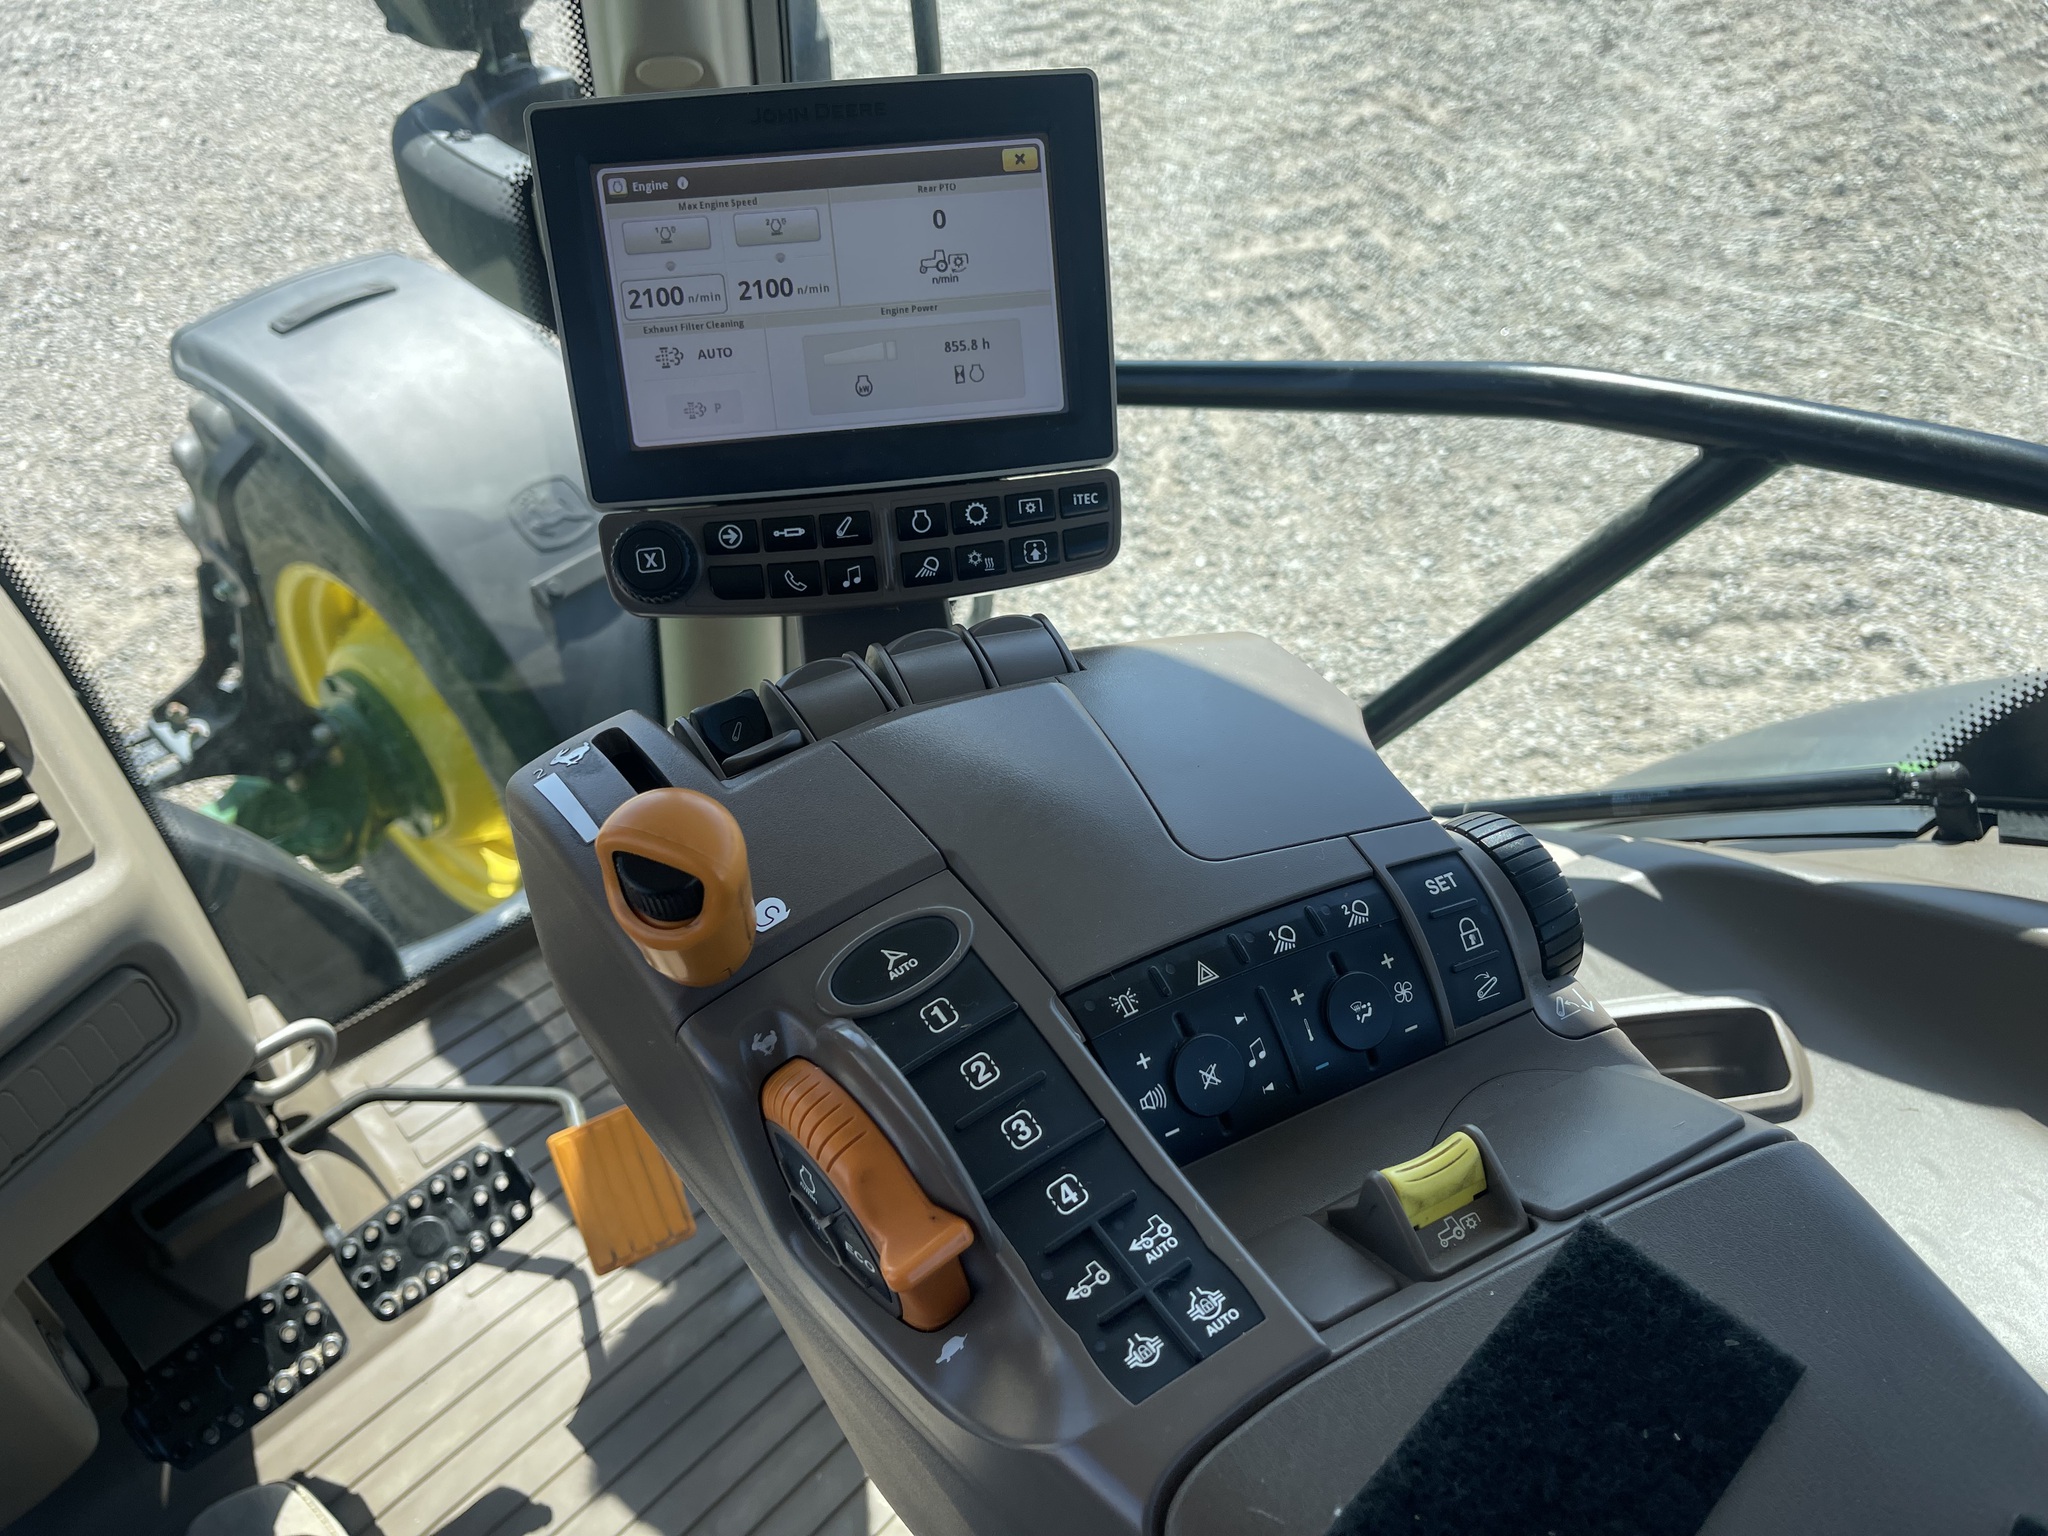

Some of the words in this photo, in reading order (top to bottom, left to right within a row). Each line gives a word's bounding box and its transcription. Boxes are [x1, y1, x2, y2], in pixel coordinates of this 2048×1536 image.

[632, 179, 669, 194] Engine
[917, 184, 937, 194] Rear
[939, 182, 957, 192] PTO
[678, 202, 698, 211] Max
[699, 199, 730, 212] Engine
[731, 196, 758, 210] Speed
[932, 208, 947, 230] 0
[737, 277, 794, 301] 2100
[796, 282, 831, 296] n/min
[932, 273, 960, 285] n/min
[628, 286, 684, 309] 2100
[688, 291, 722, 304] n/min
[880, 305, 909, 317] Engine
[911, 303, 939, 315] Power
[643, 324, 679, 335] Exhaust
[680, 321, 705, 332] Filter
[705, 318, 745, 331] Cleaning
[697, 347, 733, 361] AUTO
[944, 339, 979, 354] 855.8
[982, 337, 991, 350] h
[714, 402, 722, 414] P
[1073, 492, 1099, 506] iTEC
[1424, 871, 1458, 895] SET
[889, 958, 918, 981] AUTO
[930, 1005, 949, 1026] 1
[970, 1060, 993, 1083] 2
[1011, 1118, 1033, 1141] 3
[1059, 1182, 1079, 1205] 4
[844, 1240, 877, 1274] ECO
[1144, 1236, 1179, 1264] AUTO
[1205, 1307, 1240, 1338] AUTO
